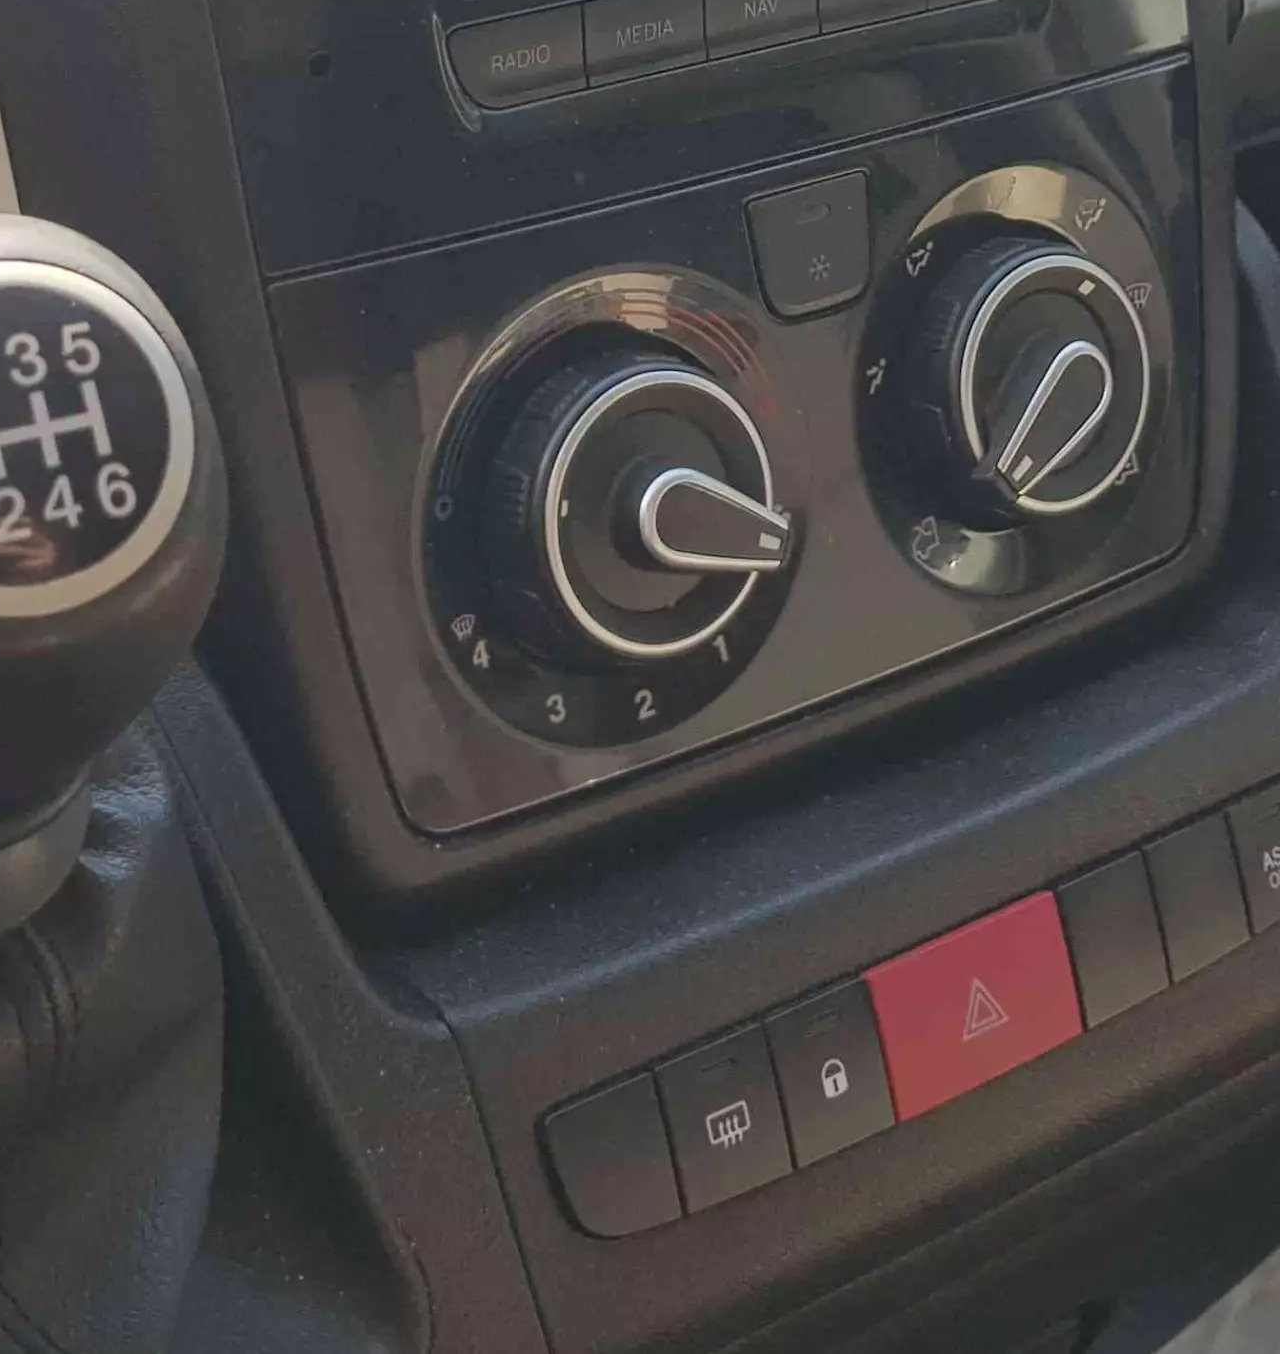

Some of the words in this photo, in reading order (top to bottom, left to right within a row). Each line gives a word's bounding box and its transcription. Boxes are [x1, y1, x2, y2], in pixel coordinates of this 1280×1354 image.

[615, 18, 675, 48] MEDIA
[490, 42, 551, 74] RADIO
[4, 332, 49, 386] 3
[60, 321, 101, 375] 5
[43, 474, 83, 529] 4
[96, 462, 138, 517] 6
[472, 639, 491, 670] 4
[711, 633, 732, 663] 1
[544, 693, 567, 724] 3
[634, 689, 658, 721] 2
